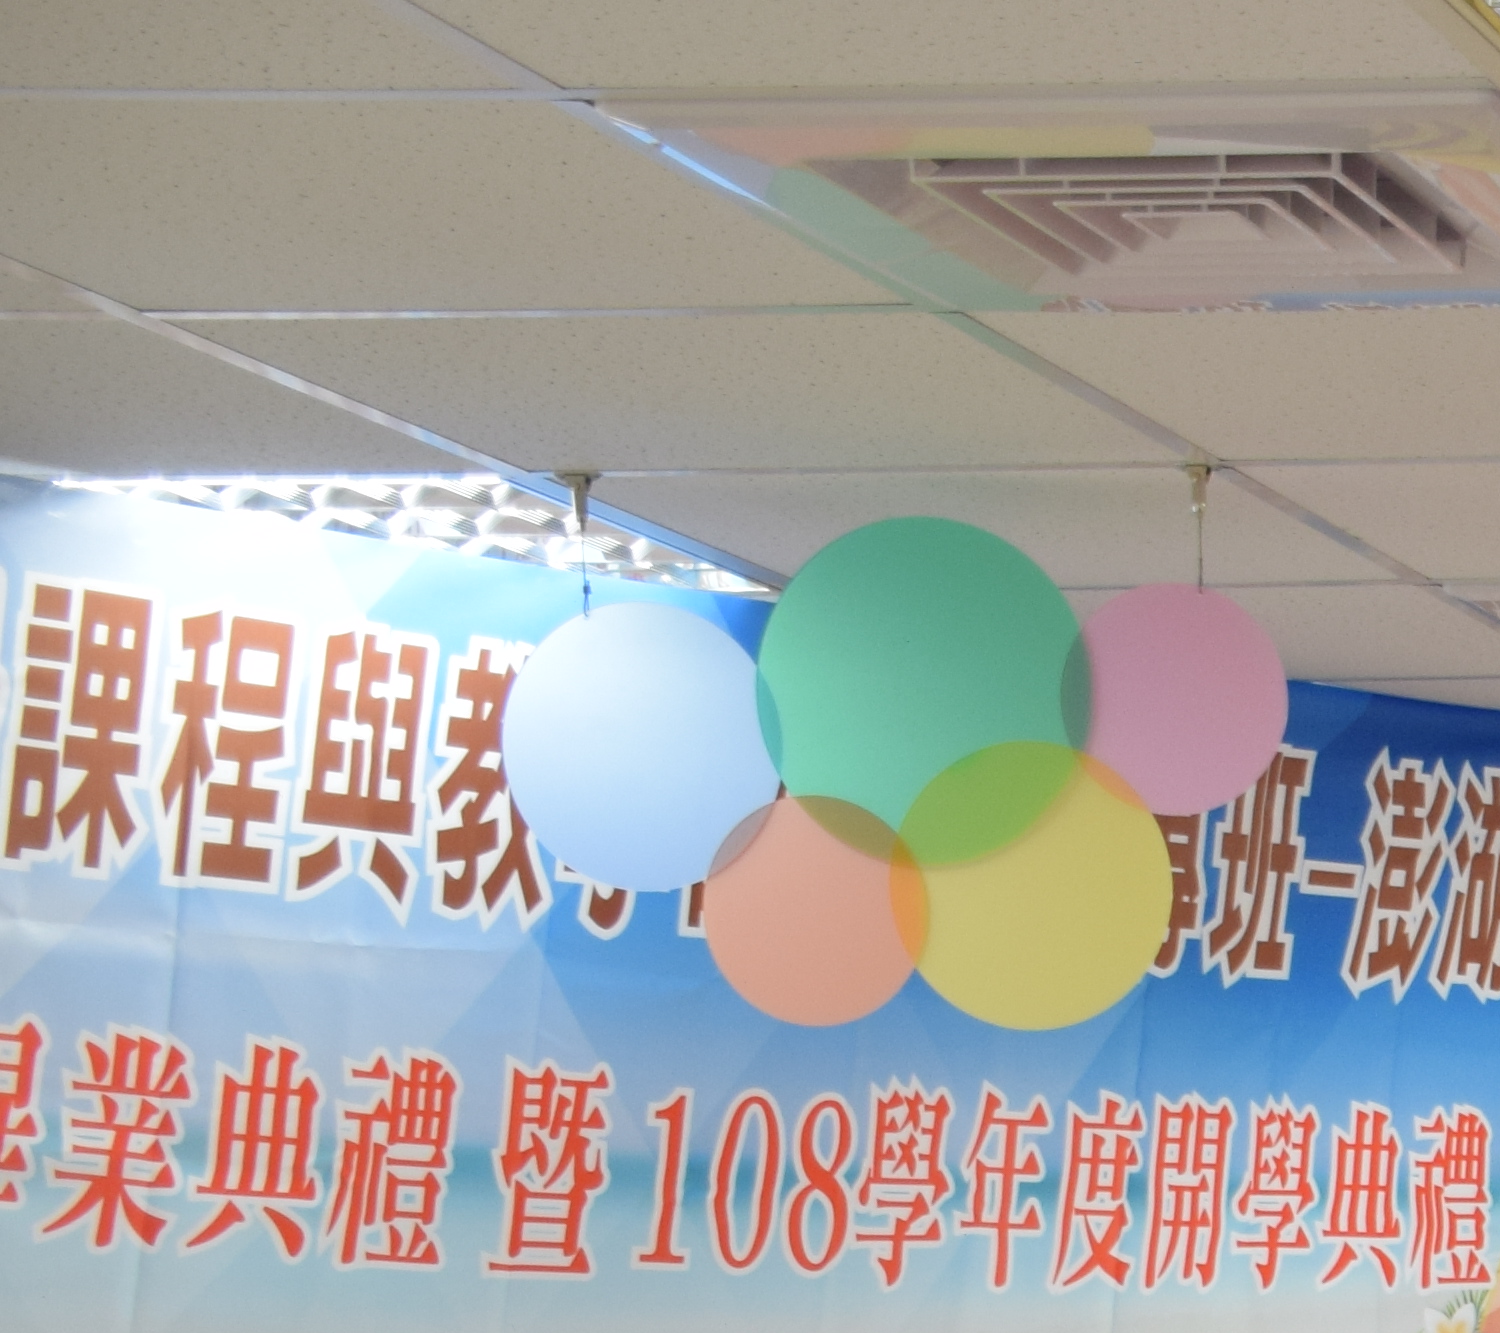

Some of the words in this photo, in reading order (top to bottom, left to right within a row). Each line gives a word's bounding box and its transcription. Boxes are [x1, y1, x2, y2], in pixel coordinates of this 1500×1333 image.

[488, 1066, 612, 1274] 暨
[638, 1078, 1492, 1288] 108學年度開學典禮
